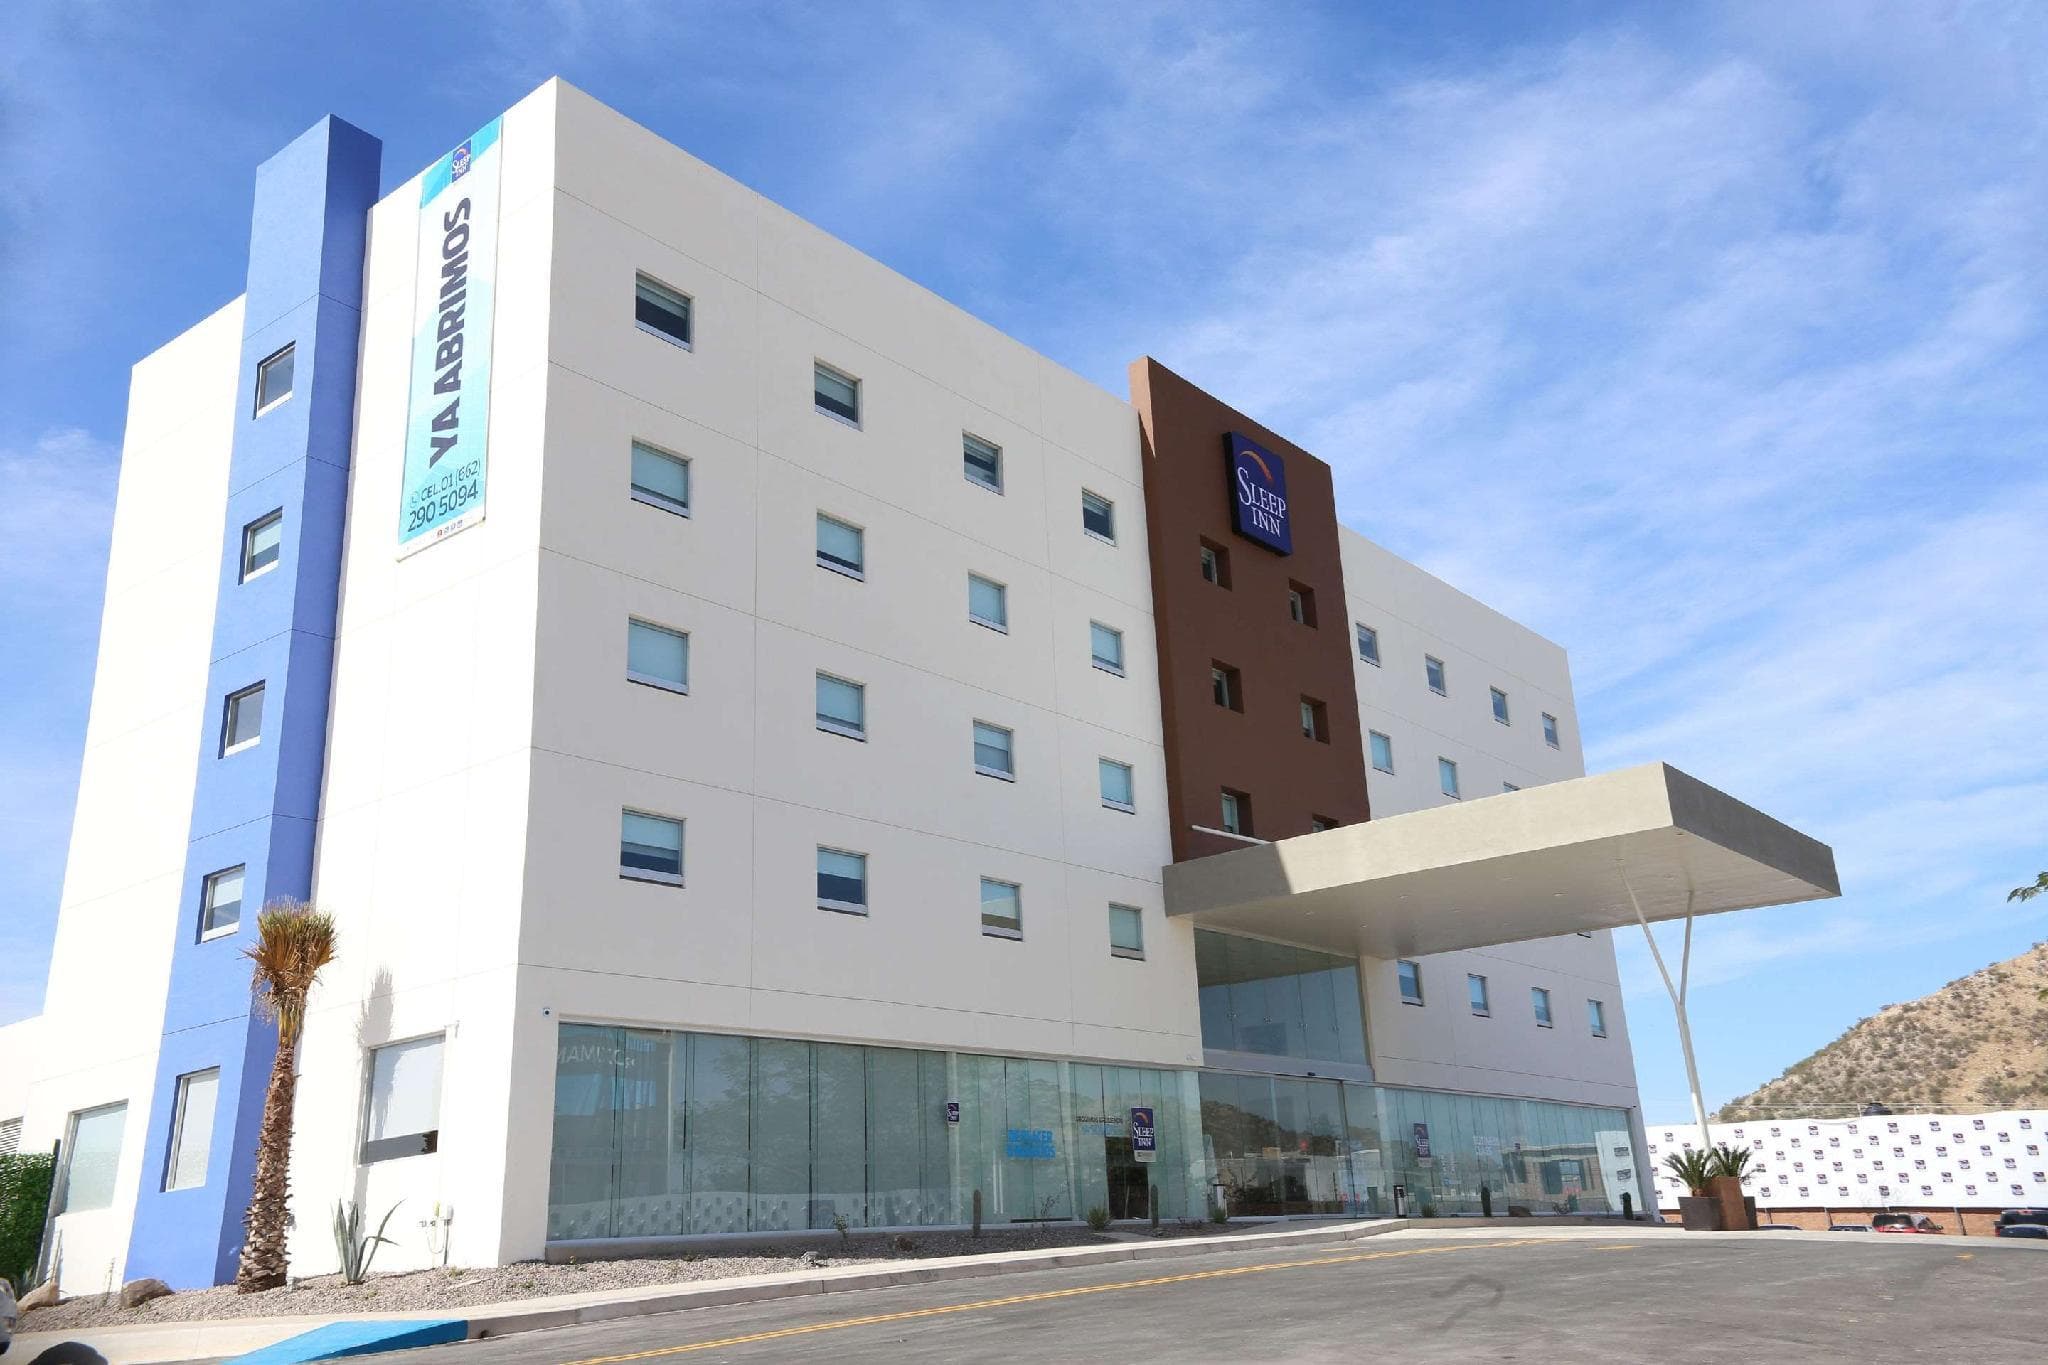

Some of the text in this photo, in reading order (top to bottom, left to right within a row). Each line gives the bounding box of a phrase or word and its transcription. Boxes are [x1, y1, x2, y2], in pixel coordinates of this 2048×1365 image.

[429, 197, 471, 469] YA ABRIMOS
[455, 458, 481, 487] (662)
[1237, 466, 1286, 519] SLEEP
[407, 479, 479, 533] 290 5094
[1251, 506, 1281, 537] INN
